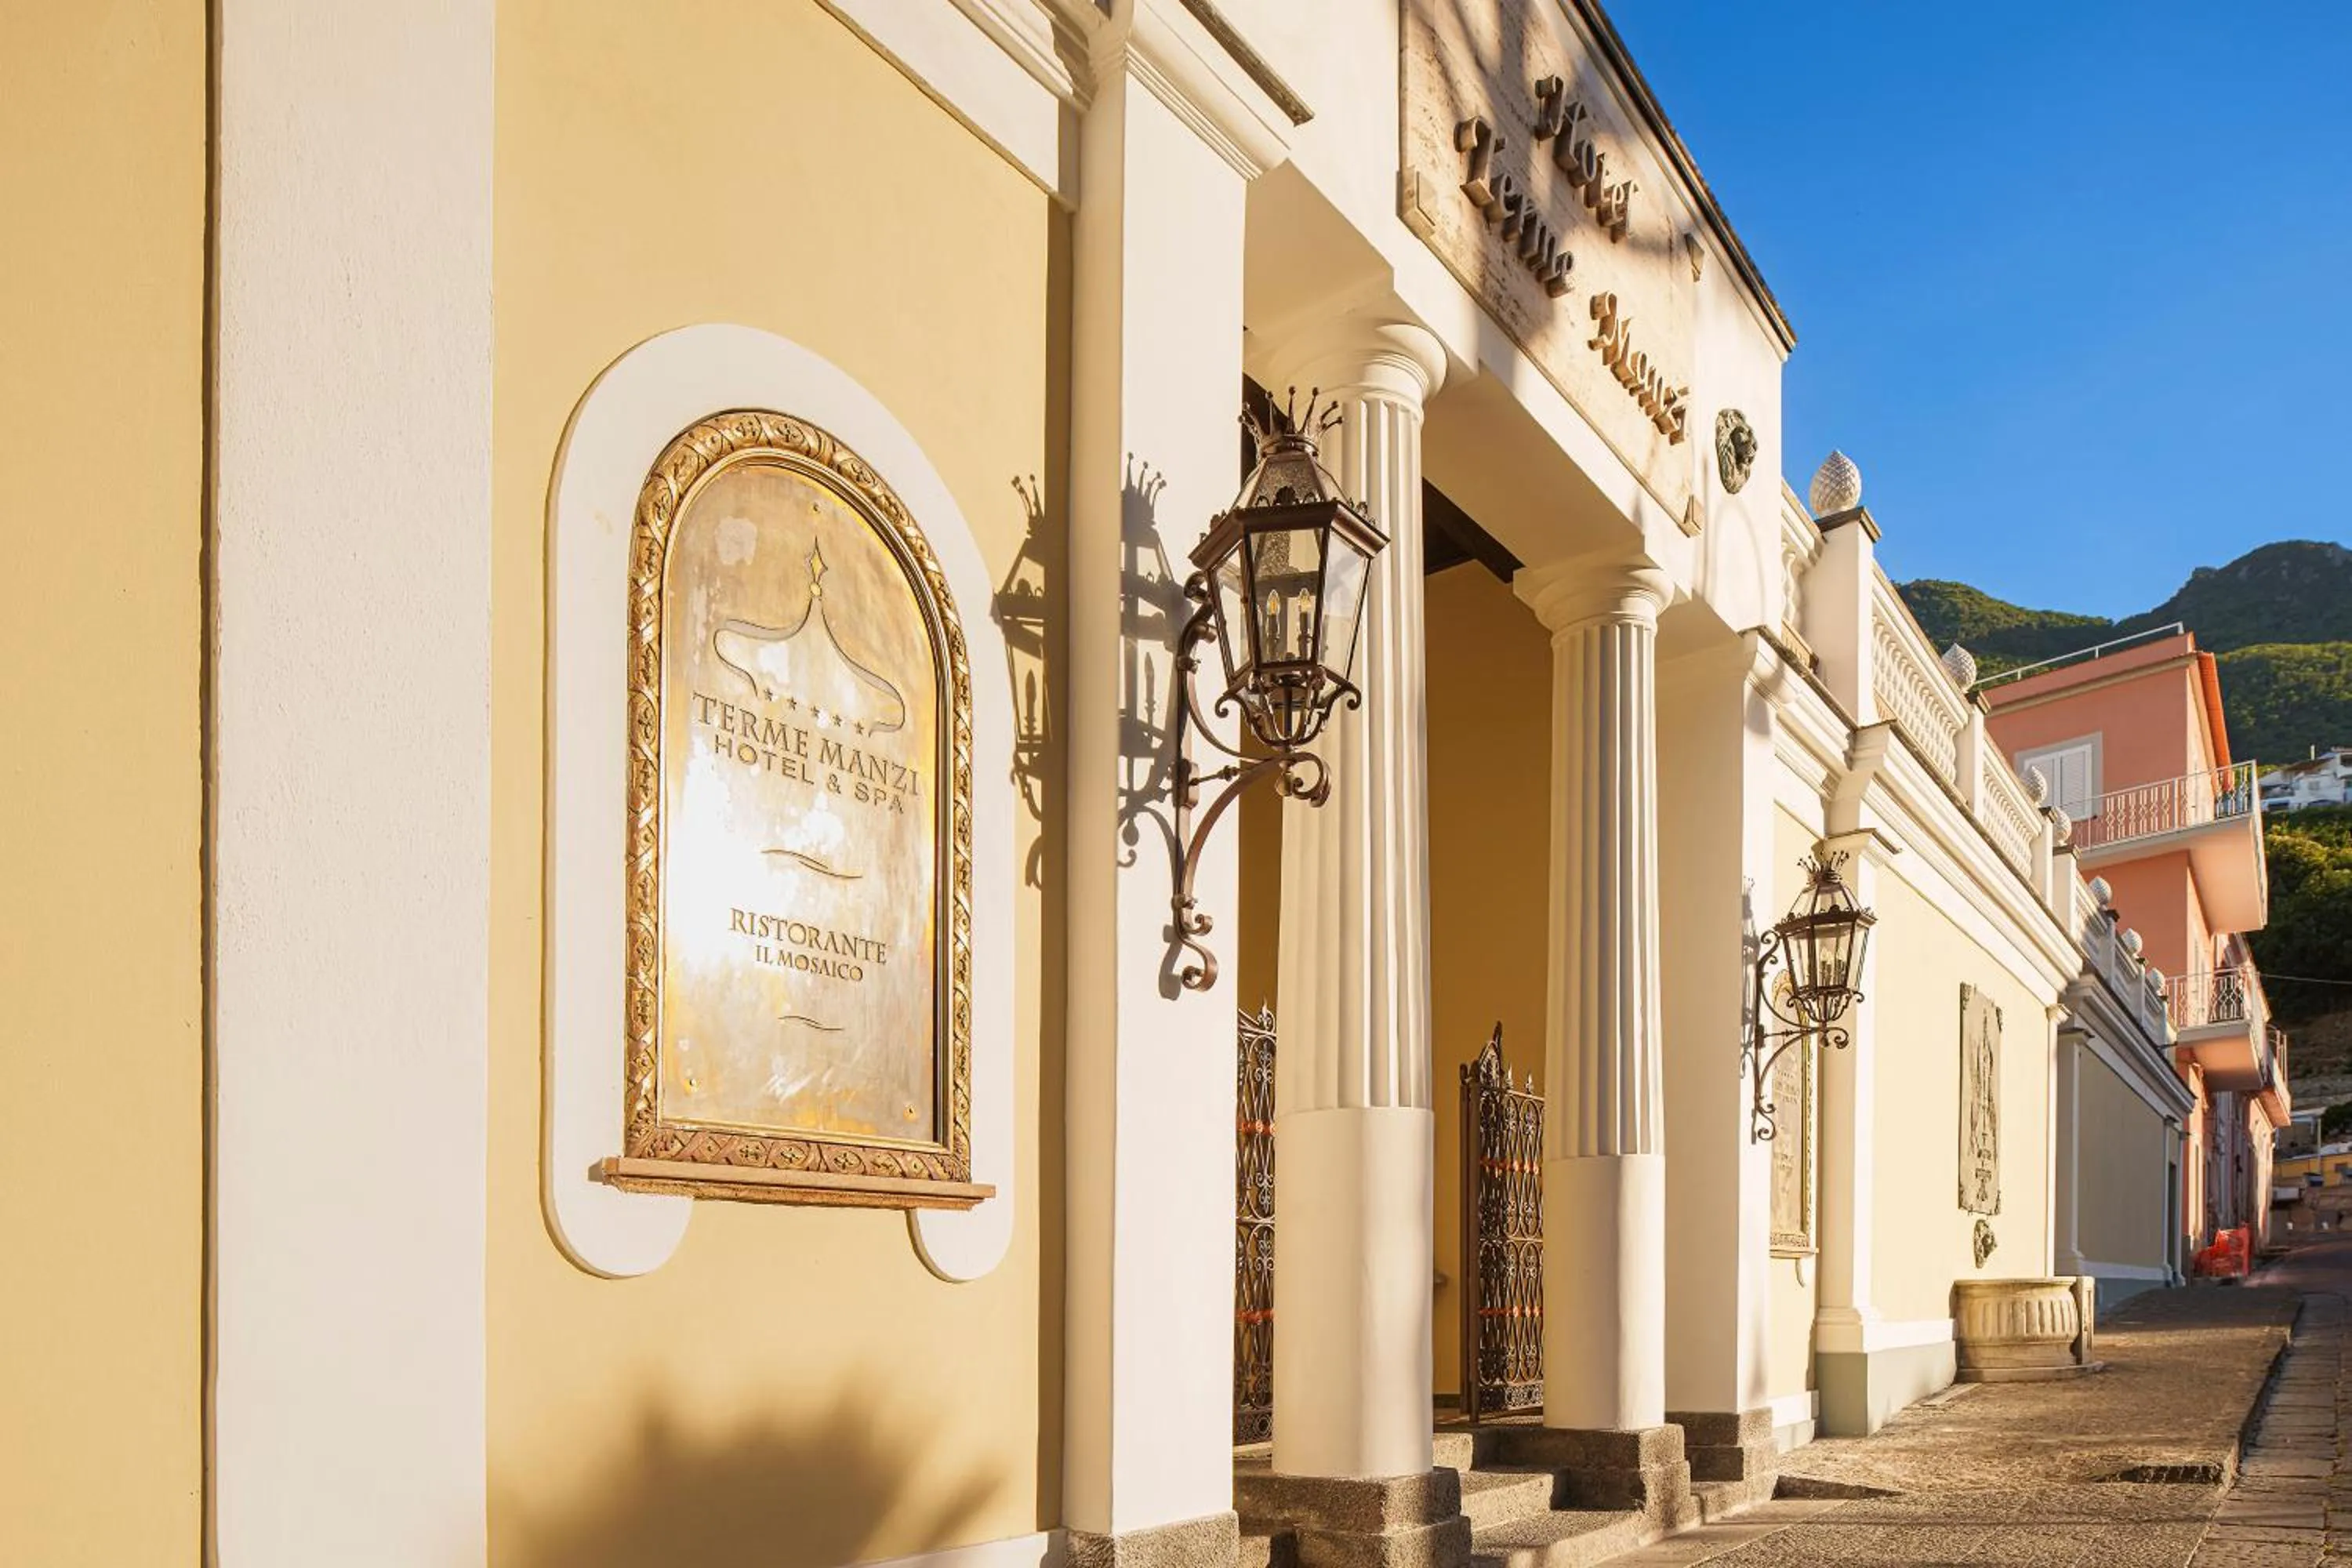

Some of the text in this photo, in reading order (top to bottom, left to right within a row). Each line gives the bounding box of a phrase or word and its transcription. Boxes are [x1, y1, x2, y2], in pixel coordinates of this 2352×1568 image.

[1453, 115, 1690, 446] Terme Manzi
[693, 690, 919, 796] TERME MANZI
[714, 734, 904, 814] HOTEL & SPA
[729, 907, 887, 964] RISTORANTE
[756, 945, 863, 982] IL MOSAICO
